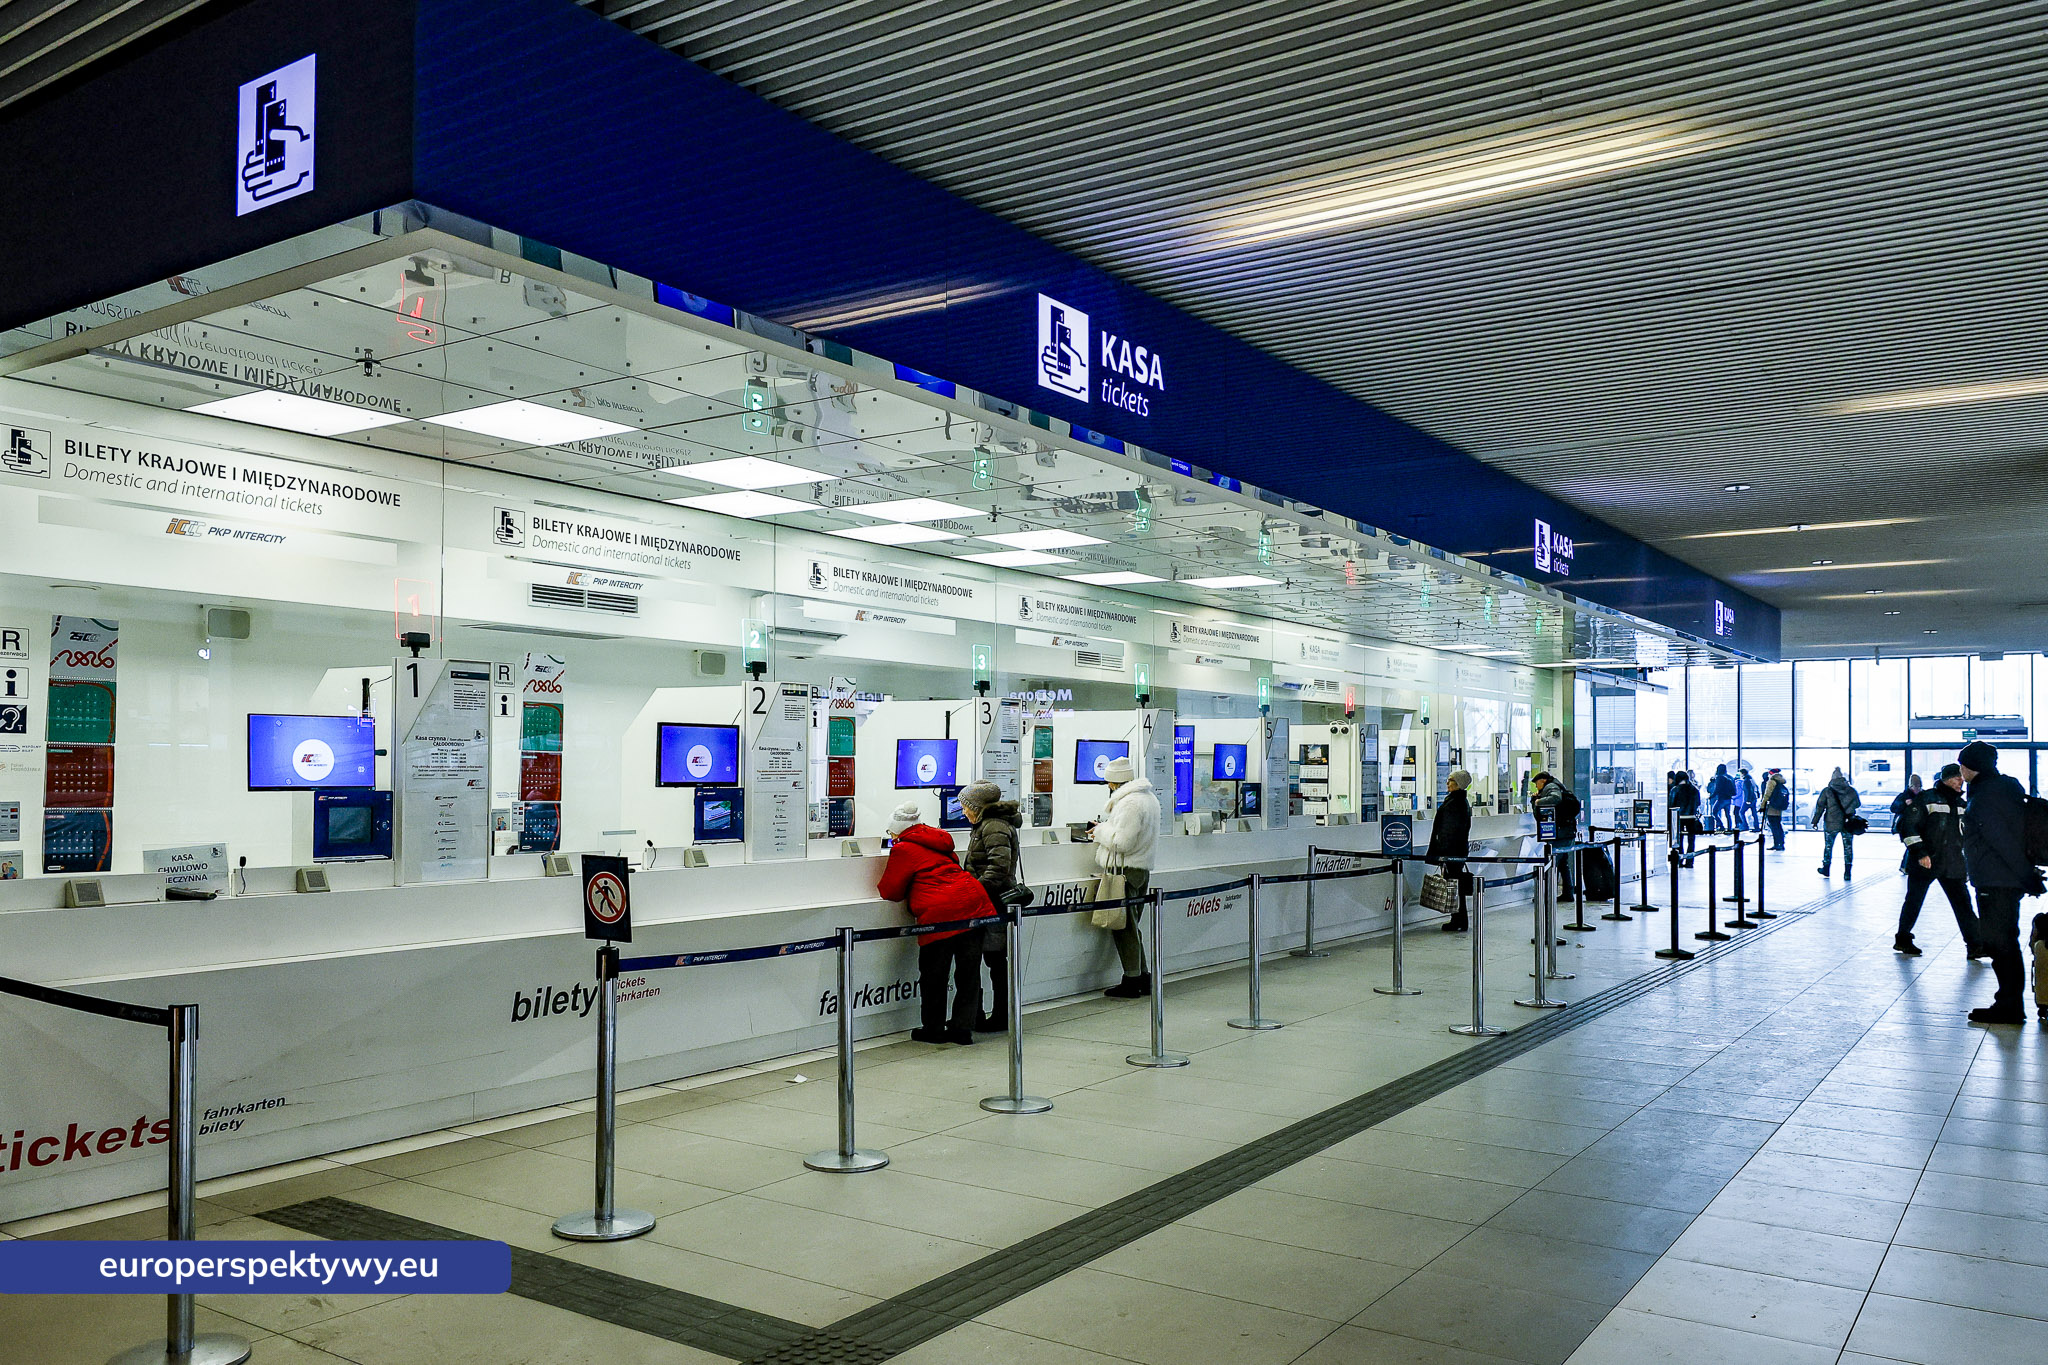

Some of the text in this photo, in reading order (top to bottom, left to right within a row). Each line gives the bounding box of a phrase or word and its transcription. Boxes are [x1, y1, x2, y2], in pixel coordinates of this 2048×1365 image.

[1101, 330, 1165, 391] KASA
[1101, 378, 1149, 417] tickets
[64, 438, 401, 508] BILETY KRAJOWE I MIĘDZYNARODOWE
[64, 462, 323, 516] Domestic and international tickets
[207, 526, 232, 537] PKP
[233, 529, 286, 544] INTERCITY
[533, 516, 741, 562] BILETY KRAJOWE I MIĘDZYNARODOWE
[532, 535, 692, 570] Domestic and international tickets
[1553, 531, 1574, 560] KASA
[1553, 557, 1569, 576] tickets
[593, 577, 608, 586] PKP
[609, 578, 643, 590] INTERCITY
[833, 566, 973, 598] BILETY KRAJOWE I MIĘDZYNARODOWE
[833, 581, 939, 607] Domestic and international tickets
[407, 593, 420, 617] 1
[1036, 600, 1137, 625] BILETY KRAJOWE I MIĘDZYNARODOWE
[883, 616, 908, 625] INTERCITY
[2, 630, 21, 651] R
[750, 630, 761, 648] 2
[978, 654, 986, 670] 3
[406, 662, 419, 698] 1
[499, 665, 510, 681] R
[1139, 671, 1146, 685] 4
[1261, 684, 1267, 697] 5
[752, 686, 767, 715] 2
[981, 701, 992, 725] 3
[1143, 713, 1152, 734] 4
[1266, 721, 1273, 739] 5
[1359, 727, 1366, 744] 6
[1434, 732, 1439, 747] 7
[1495, 736, 1500, 749] 8
[171, 853, 194, 862] KASA
[1315, 856, 1351, 873] hrkarten
[158, 862, 208, 874] CHWILOWO
[165, 873, 208, 884] IECZYNNA
[1044, 882, 1088, 906] bilety
[1186, 895, 1222, 918] tickets
[693, 955, 704, 963] PKP
[704, 953, 728, 962] INTERCITY
[617, 976, 646, 990] ickets
[511, 981, 599, 1022] bilety
[615, 987, 661, 1004] ahrkarten
[203, 1096, 286, 1121] fahrkarten
[198, 1117, 245, 1136] bilety
